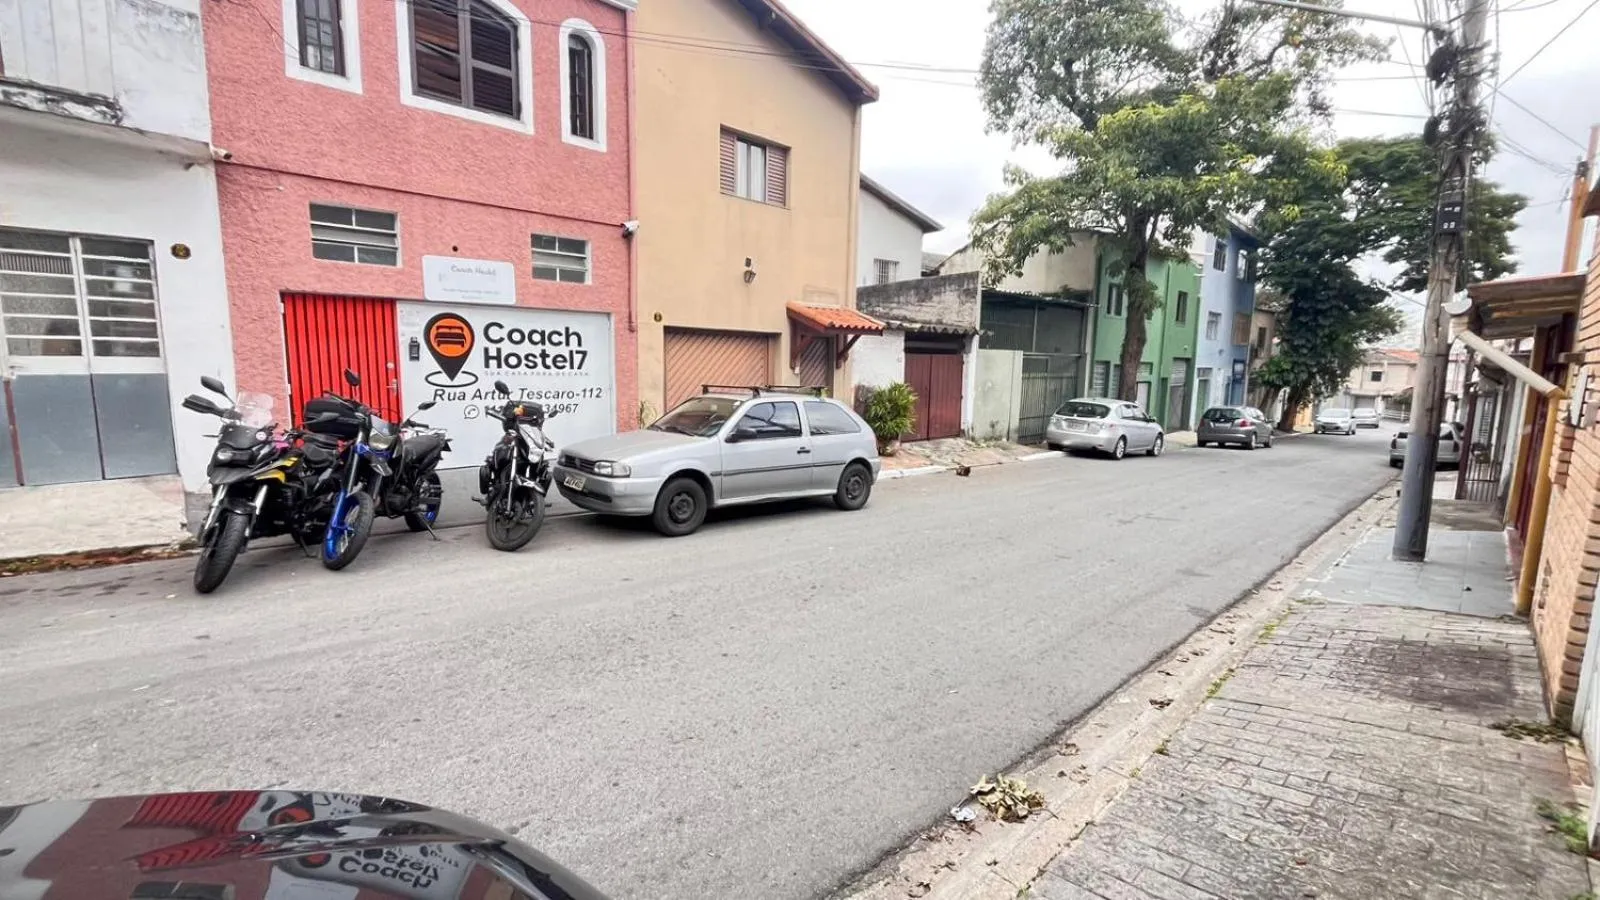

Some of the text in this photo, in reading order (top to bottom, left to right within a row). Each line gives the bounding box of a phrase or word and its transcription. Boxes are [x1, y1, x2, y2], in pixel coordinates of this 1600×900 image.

[483, 321, 582, 347] Coach
[483, 347, 588, 370] Hostel7
[433, 388, 466, 401] Rua
[519, 387, 603, 400] Tescaro-112
